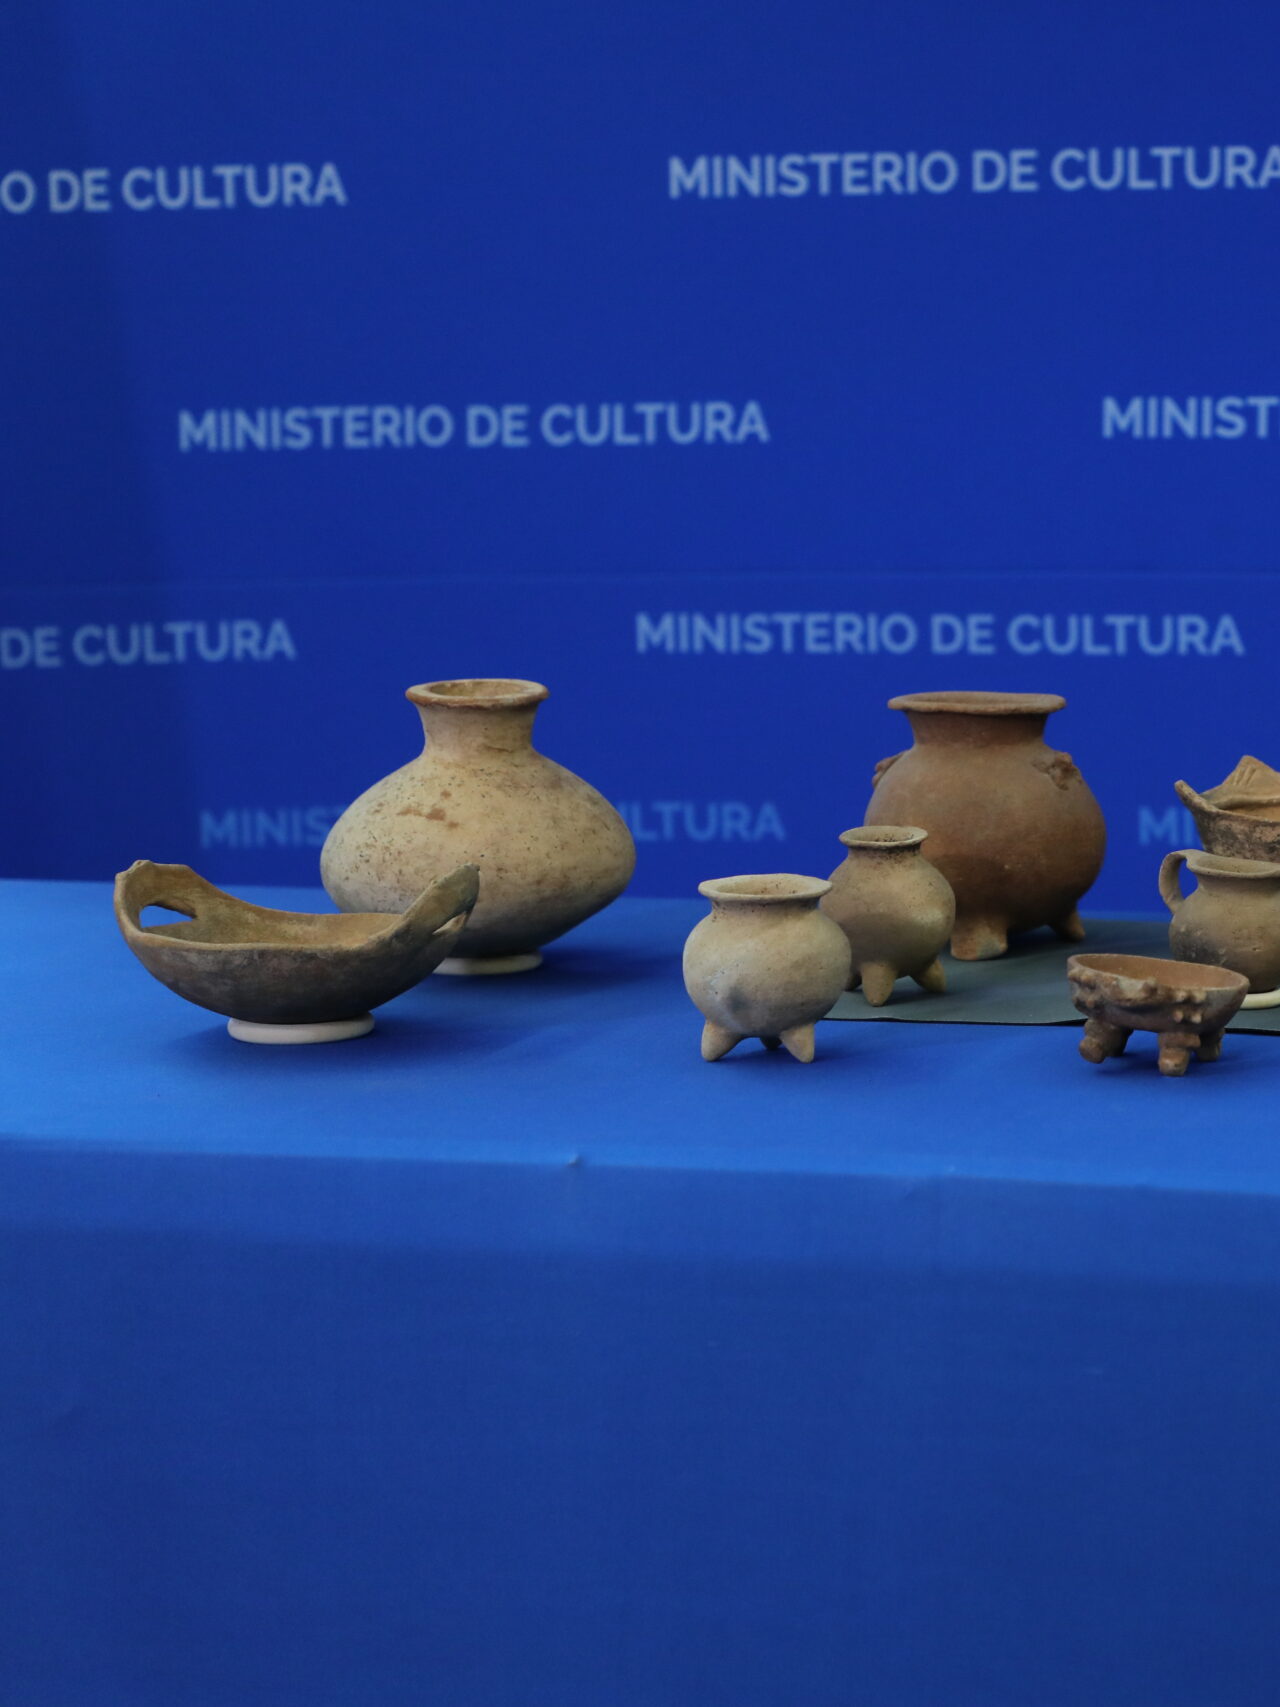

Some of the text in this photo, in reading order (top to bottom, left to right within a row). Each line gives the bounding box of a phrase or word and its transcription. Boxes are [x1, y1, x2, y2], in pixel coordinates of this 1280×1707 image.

[48, 168, 112, 213] DE
[121, 161, 349, 211] CULTURA
[668, 150, 959, 200] MINISTERIO
[971, 148, 1039, 194] DE
[178, 400, 770, 453] MINISTERIO DE CULTURA
[72, 619, 297, 667] CULTURA
[635, 611, 1246, 657] MINISTERIO DE CULTURA
[201, 806, 347, 849] MINIS
